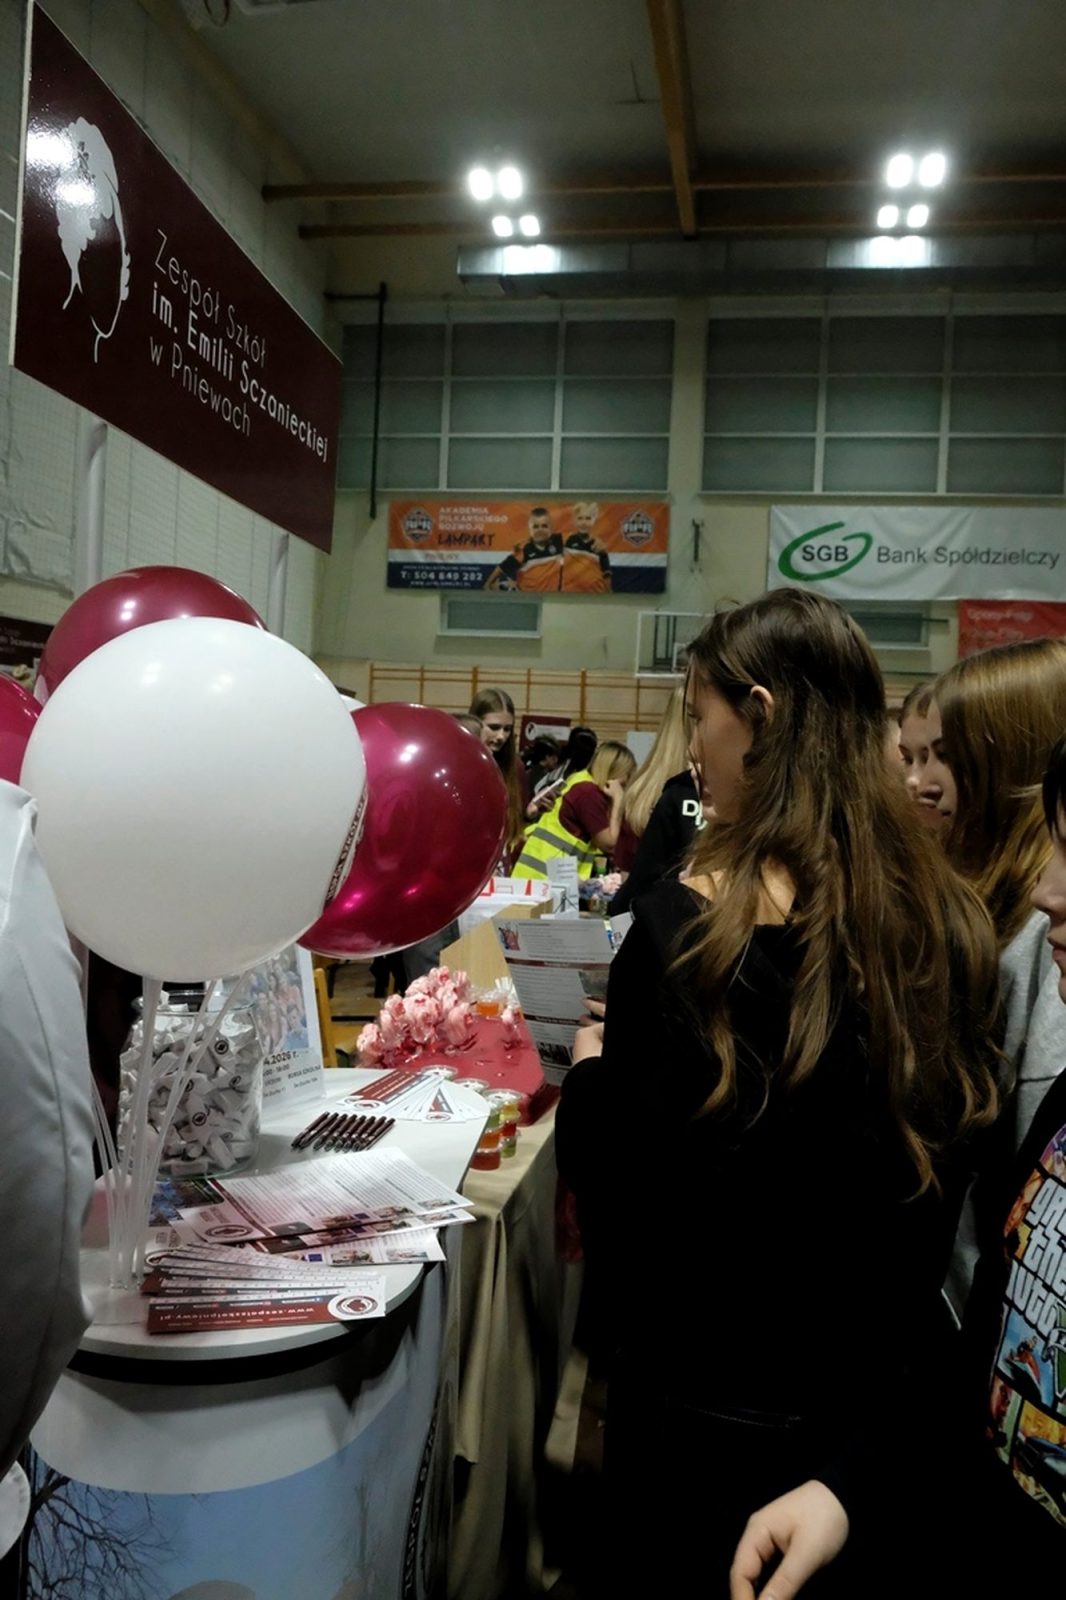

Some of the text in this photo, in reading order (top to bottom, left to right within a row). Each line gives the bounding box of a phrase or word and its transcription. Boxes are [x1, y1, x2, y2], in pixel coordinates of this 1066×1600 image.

[155, 228, 266, 368] Zespół Szkół
[152, 281, 328, 463] im. Emilii Sczanieckiej
[150, 336, 250, 437] w Pniewach
[439, 506, 489, 514] AKADEMIA
[437, 532, 496, 547] LAMPART
[802, 544, 849, 563] SGB
[876, 546, 1061, 570] Bank Spółdzielczy
[413, 571, 436, 580] 504
